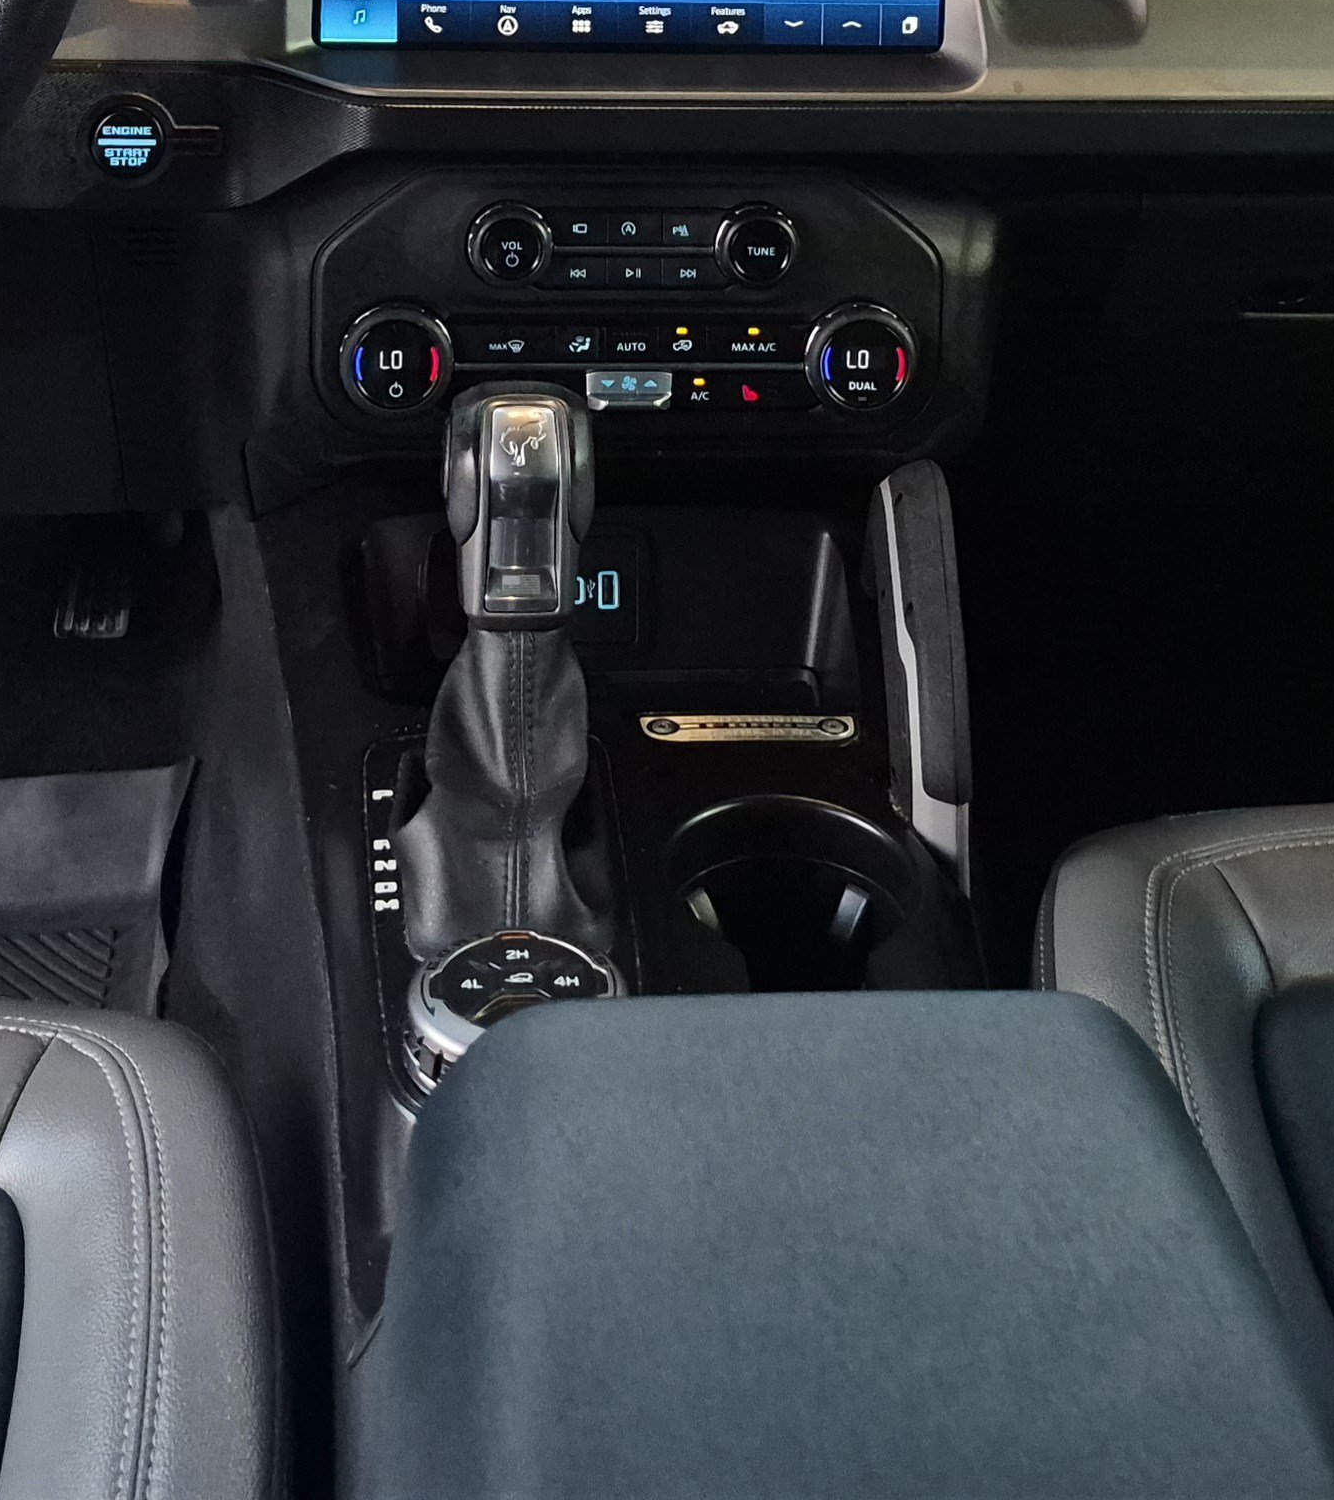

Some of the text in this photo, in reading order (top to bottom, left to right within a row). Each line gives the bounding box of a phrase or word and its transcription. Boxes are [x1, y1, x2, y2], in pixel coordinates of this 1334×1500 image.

[420, 3, 447, 14] Phone
[500, 4, 517, 14] Nav
[571, 5, 592, 16] Apps
[638, 5, 672, 17] Settings
[710, 6, 746, 17] Features
[102, 125, 153, 136] ENGINE
[104, 147, 151, 158] START
[110, 157, 148, 167] STOP
[501, 241, 523, 251] VOL
[747, 246, 776, 256] TUNE
[488, 341, 509, 351] MAX
[616, 341, 646, 351] AUTO
[731, 342, 776, 354] MAX A/C
[378, 350, 403, 371] LO
[845, 348, 870, 370] LO
[848, 381, 877, 391] DUAL
[689, 390, 710, 402] A/C
[505, 949, 530, 960] 2H
[460, 978, 484, 990] 4L
[553, 976, 581, 988] 4H
